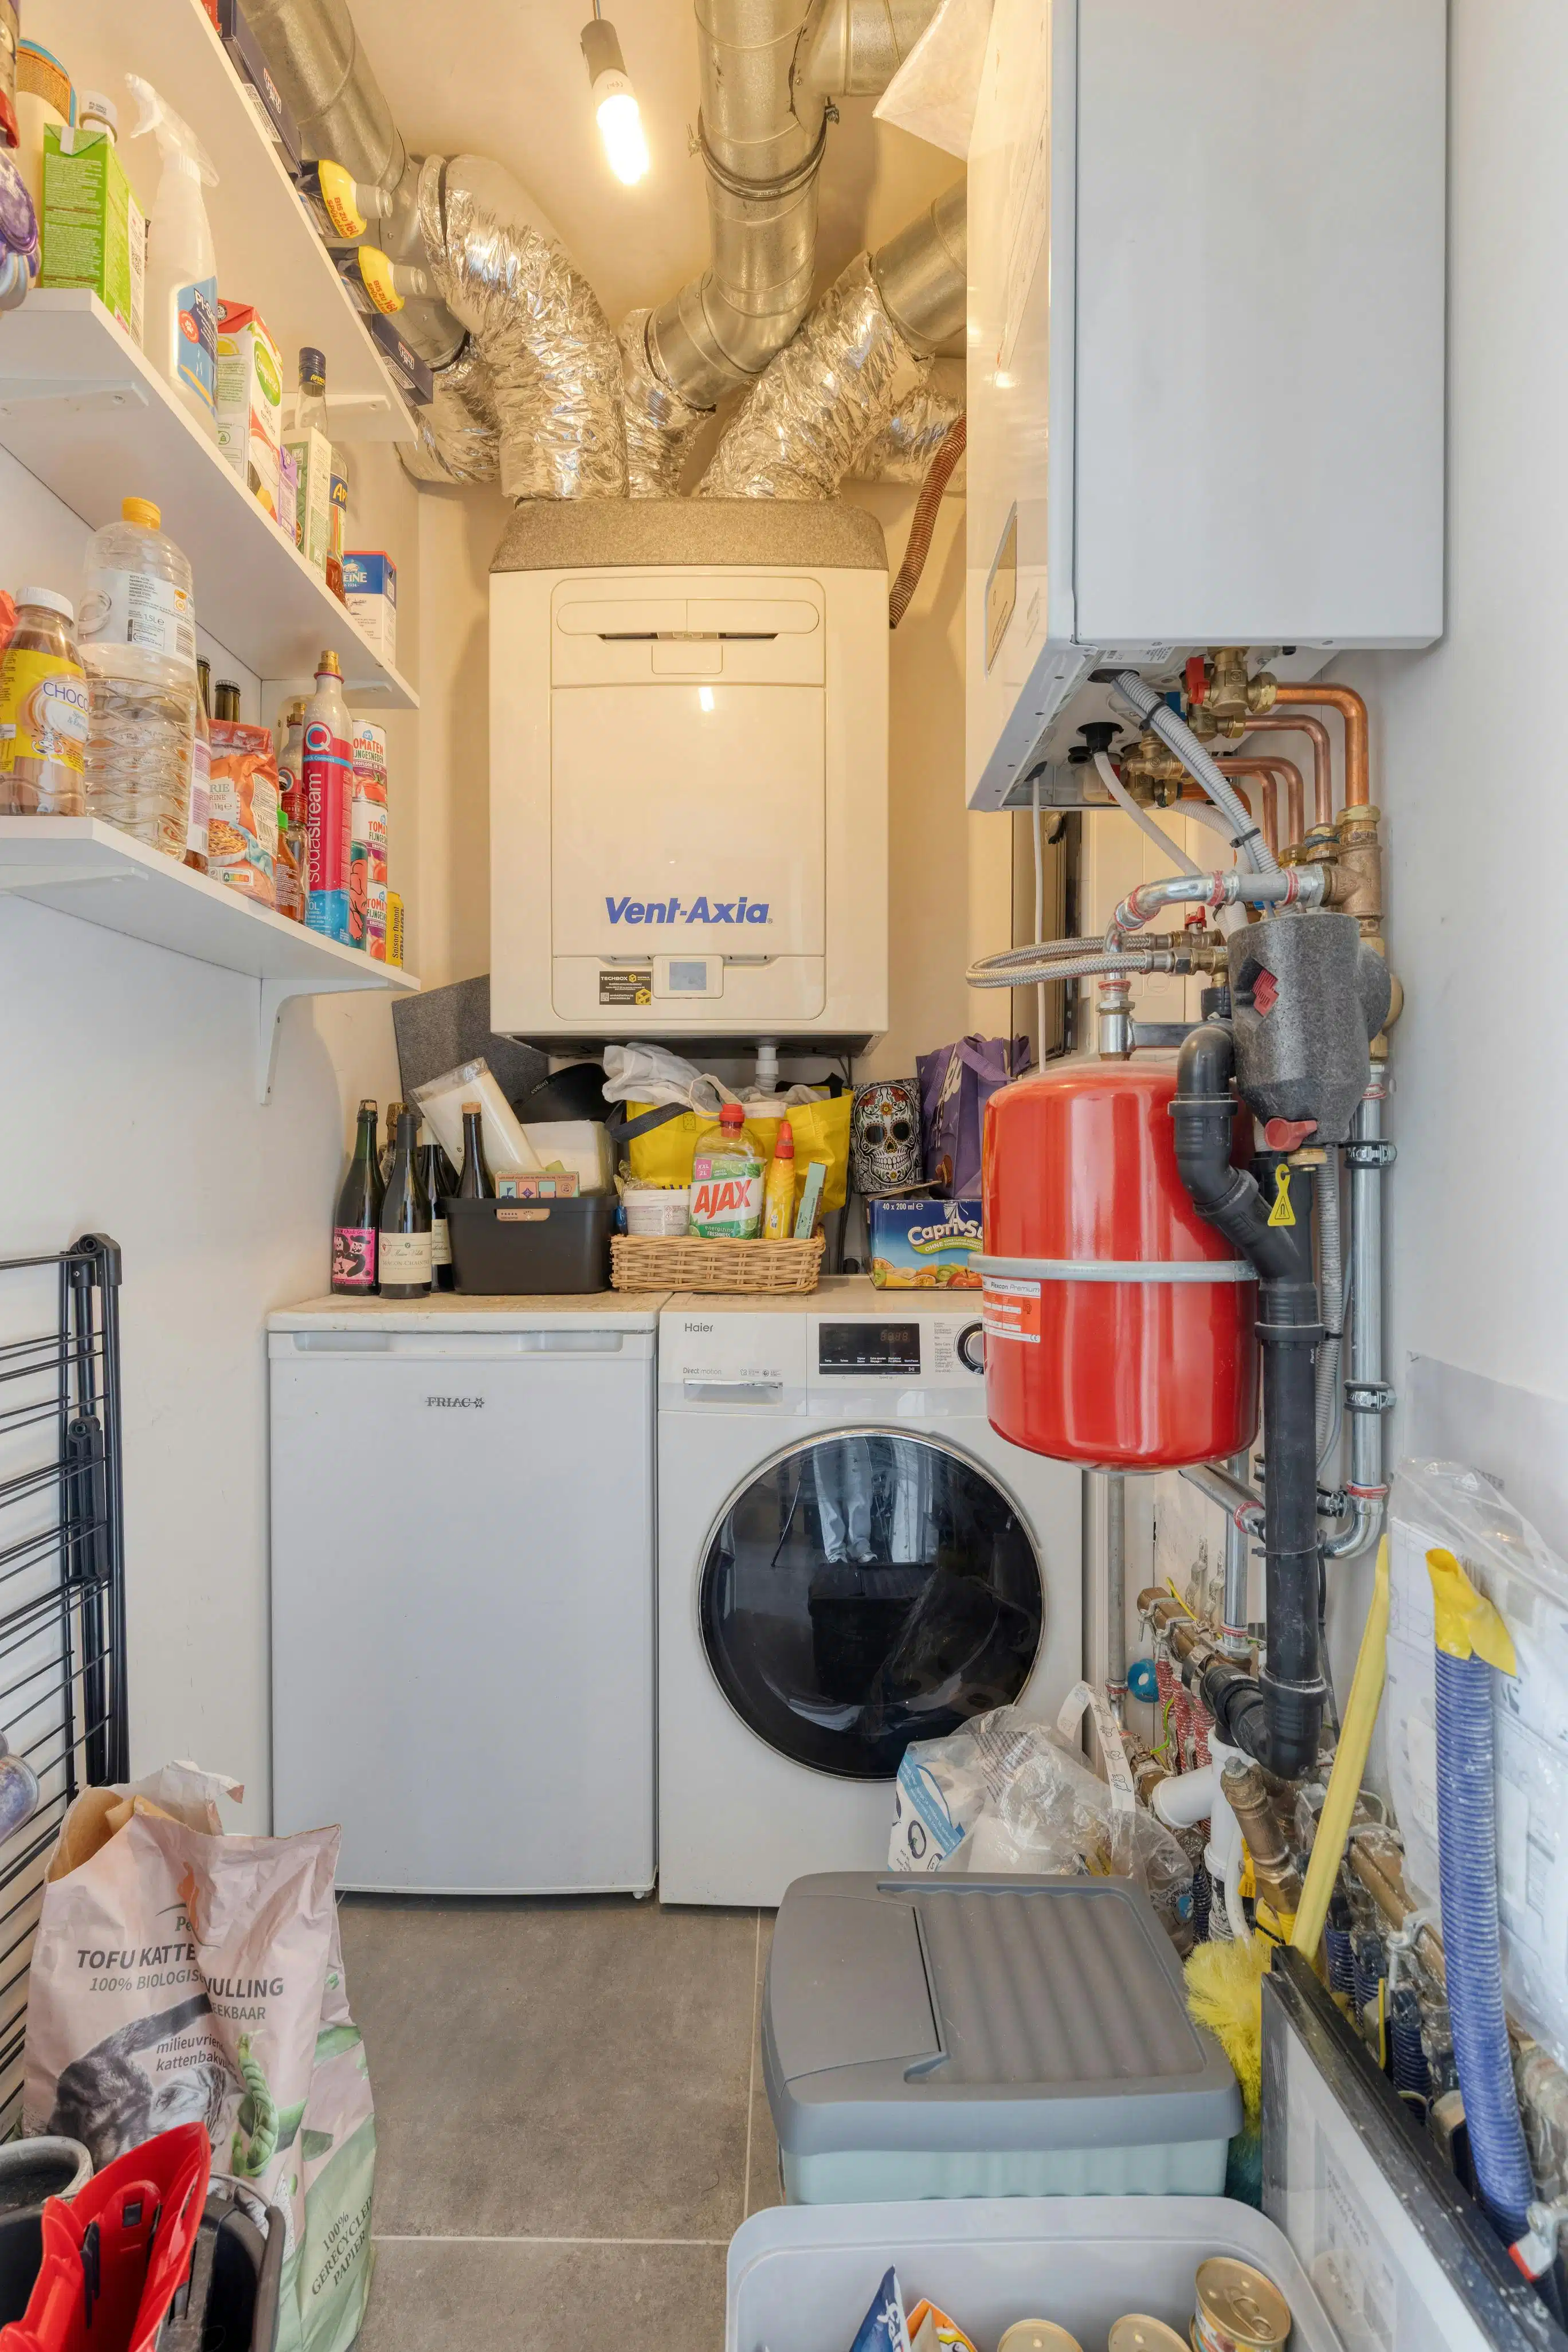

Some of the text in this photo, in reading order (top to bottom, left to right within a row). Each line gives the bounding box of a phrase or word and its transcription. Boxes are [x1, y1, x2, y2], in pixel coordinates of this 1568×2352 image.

[335, 197, 343, 211] BIS
[339, 211, 347, 222] ZU
[353, 738, 383, 756] OMATEN
[308, 773, 322, 883] sodastream
[369, 821, 386, 835] TOMA
[605, 897, 769, 924] Vent-Axia
[693, 1179, 752, 1220] AJAX
[926, 1241, 943, 1252] OHNE
[991, 1281, 1040, 1293] Flexcon Premium
[684, 1323, 714, 1332] Haier
[427, 1397, 470, 1407] FRIAC
[175, 1916, 191, 1932] Pe
[77, 1943, 195, 1969] TOFU KATTE
[89, 1977, 132, 1992] 100%
[323, 2212, 349, 2251] 100%
[311, 2196, 372, 2295] GERECYCLED
[334, 2229, 366, 2287] PAPIER
